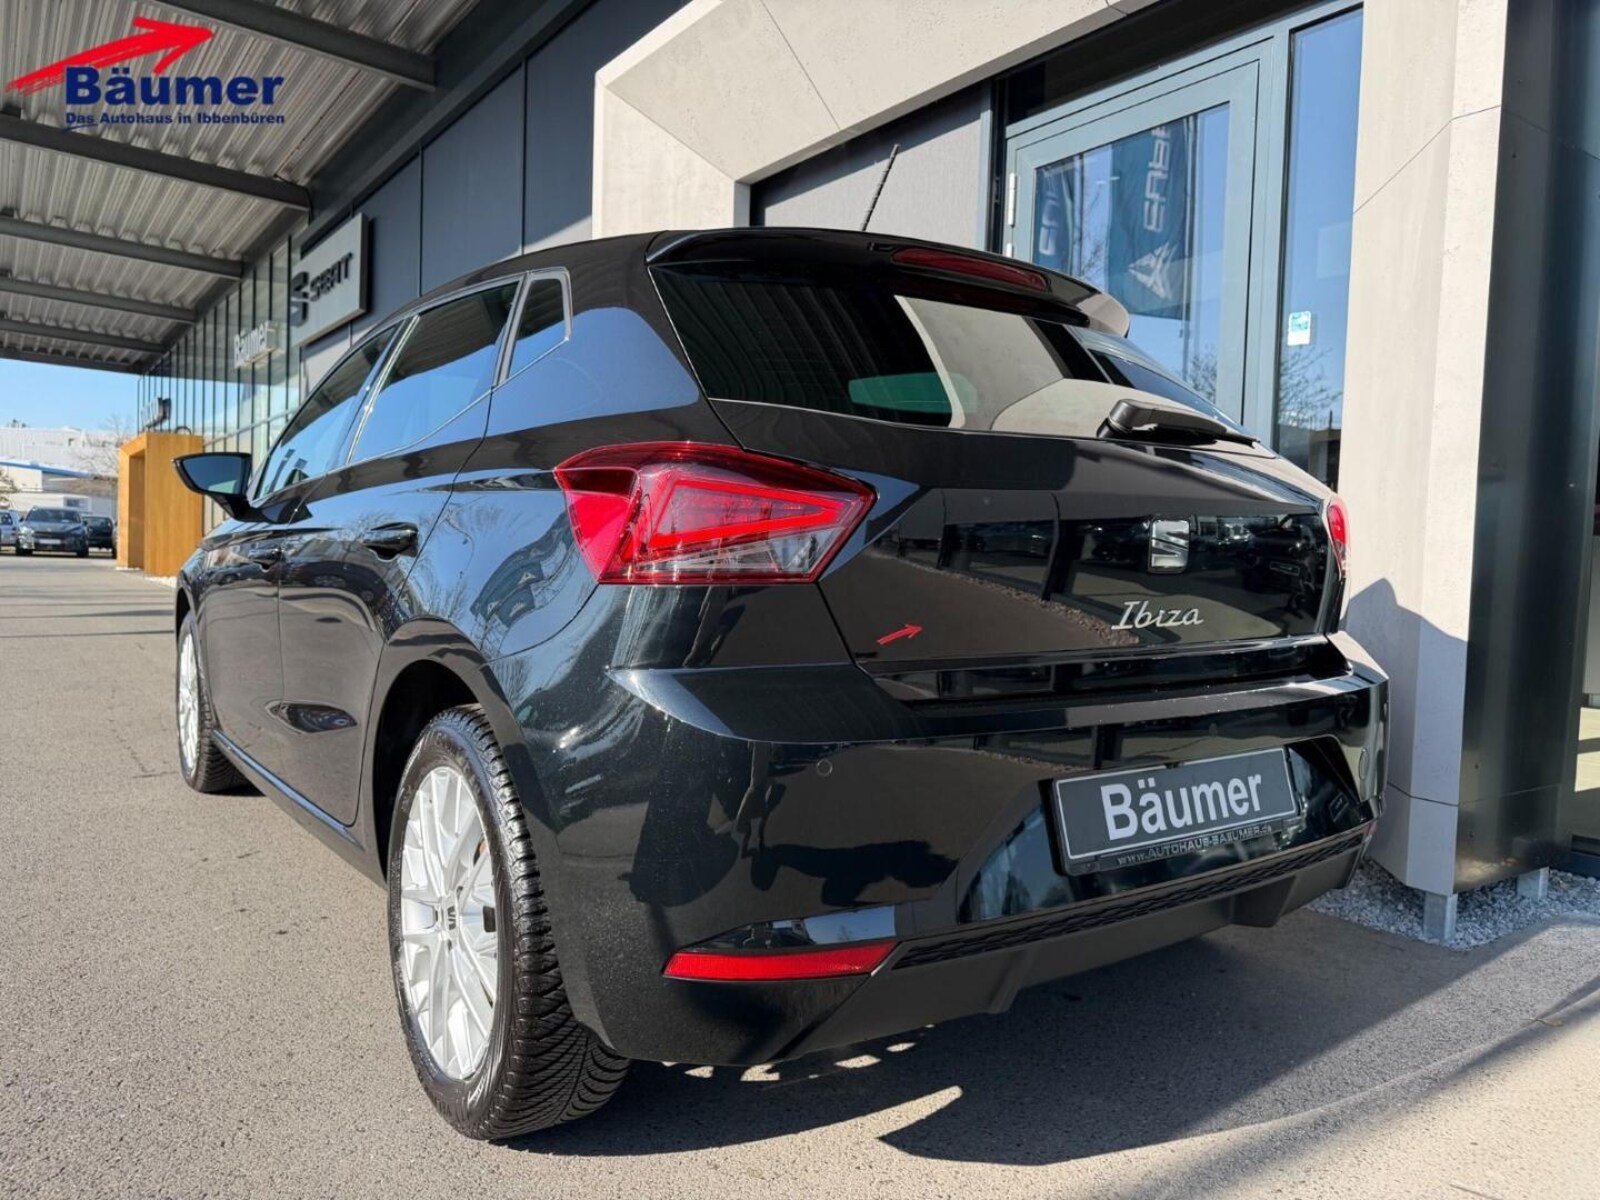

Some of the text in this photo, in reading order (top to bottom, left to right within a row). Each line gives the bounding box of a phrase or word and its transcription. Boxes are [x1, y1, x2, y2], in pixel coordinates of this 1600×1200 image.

[310, 252, 352, 302] SEAT
[1111, 600, 1204, 630] Ibiza
[1100, 773, 1262, 841] Bäumer
